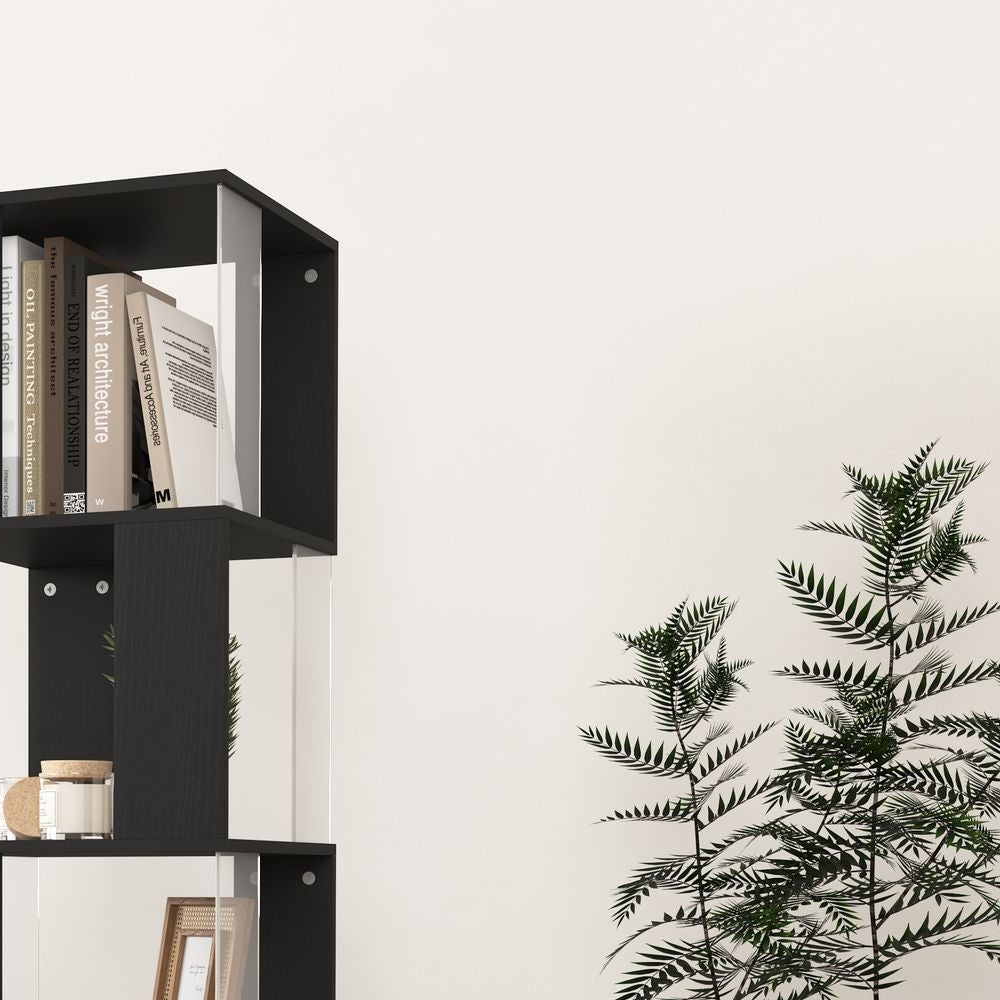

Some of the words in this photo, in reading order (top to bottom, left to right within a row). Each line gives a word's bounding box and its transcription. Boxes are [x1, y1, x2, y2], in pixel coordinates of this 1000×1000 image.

[50, 247, 58, 269] the
[2, 266, 13, 305] Light
[26, 288, 35, 317] OIL
[50, 275, 58, 326] famous
[93, 284, 111, 337] wright
[2, 312, 13, 326] in
[67, 303, 80, 331] END
[2, 331, 13, 386] design
[26, 323, 35, 405] PAINTING
[50, 332, 58, 397] architect
[67, 335, 80, 352] OF
[67, 358, 80, 467] REALATIONSHIP
[94, 343, 113, 444] architecture
[24, 414, 36, 493] Techniques
[156, 488, 171, 504] M
